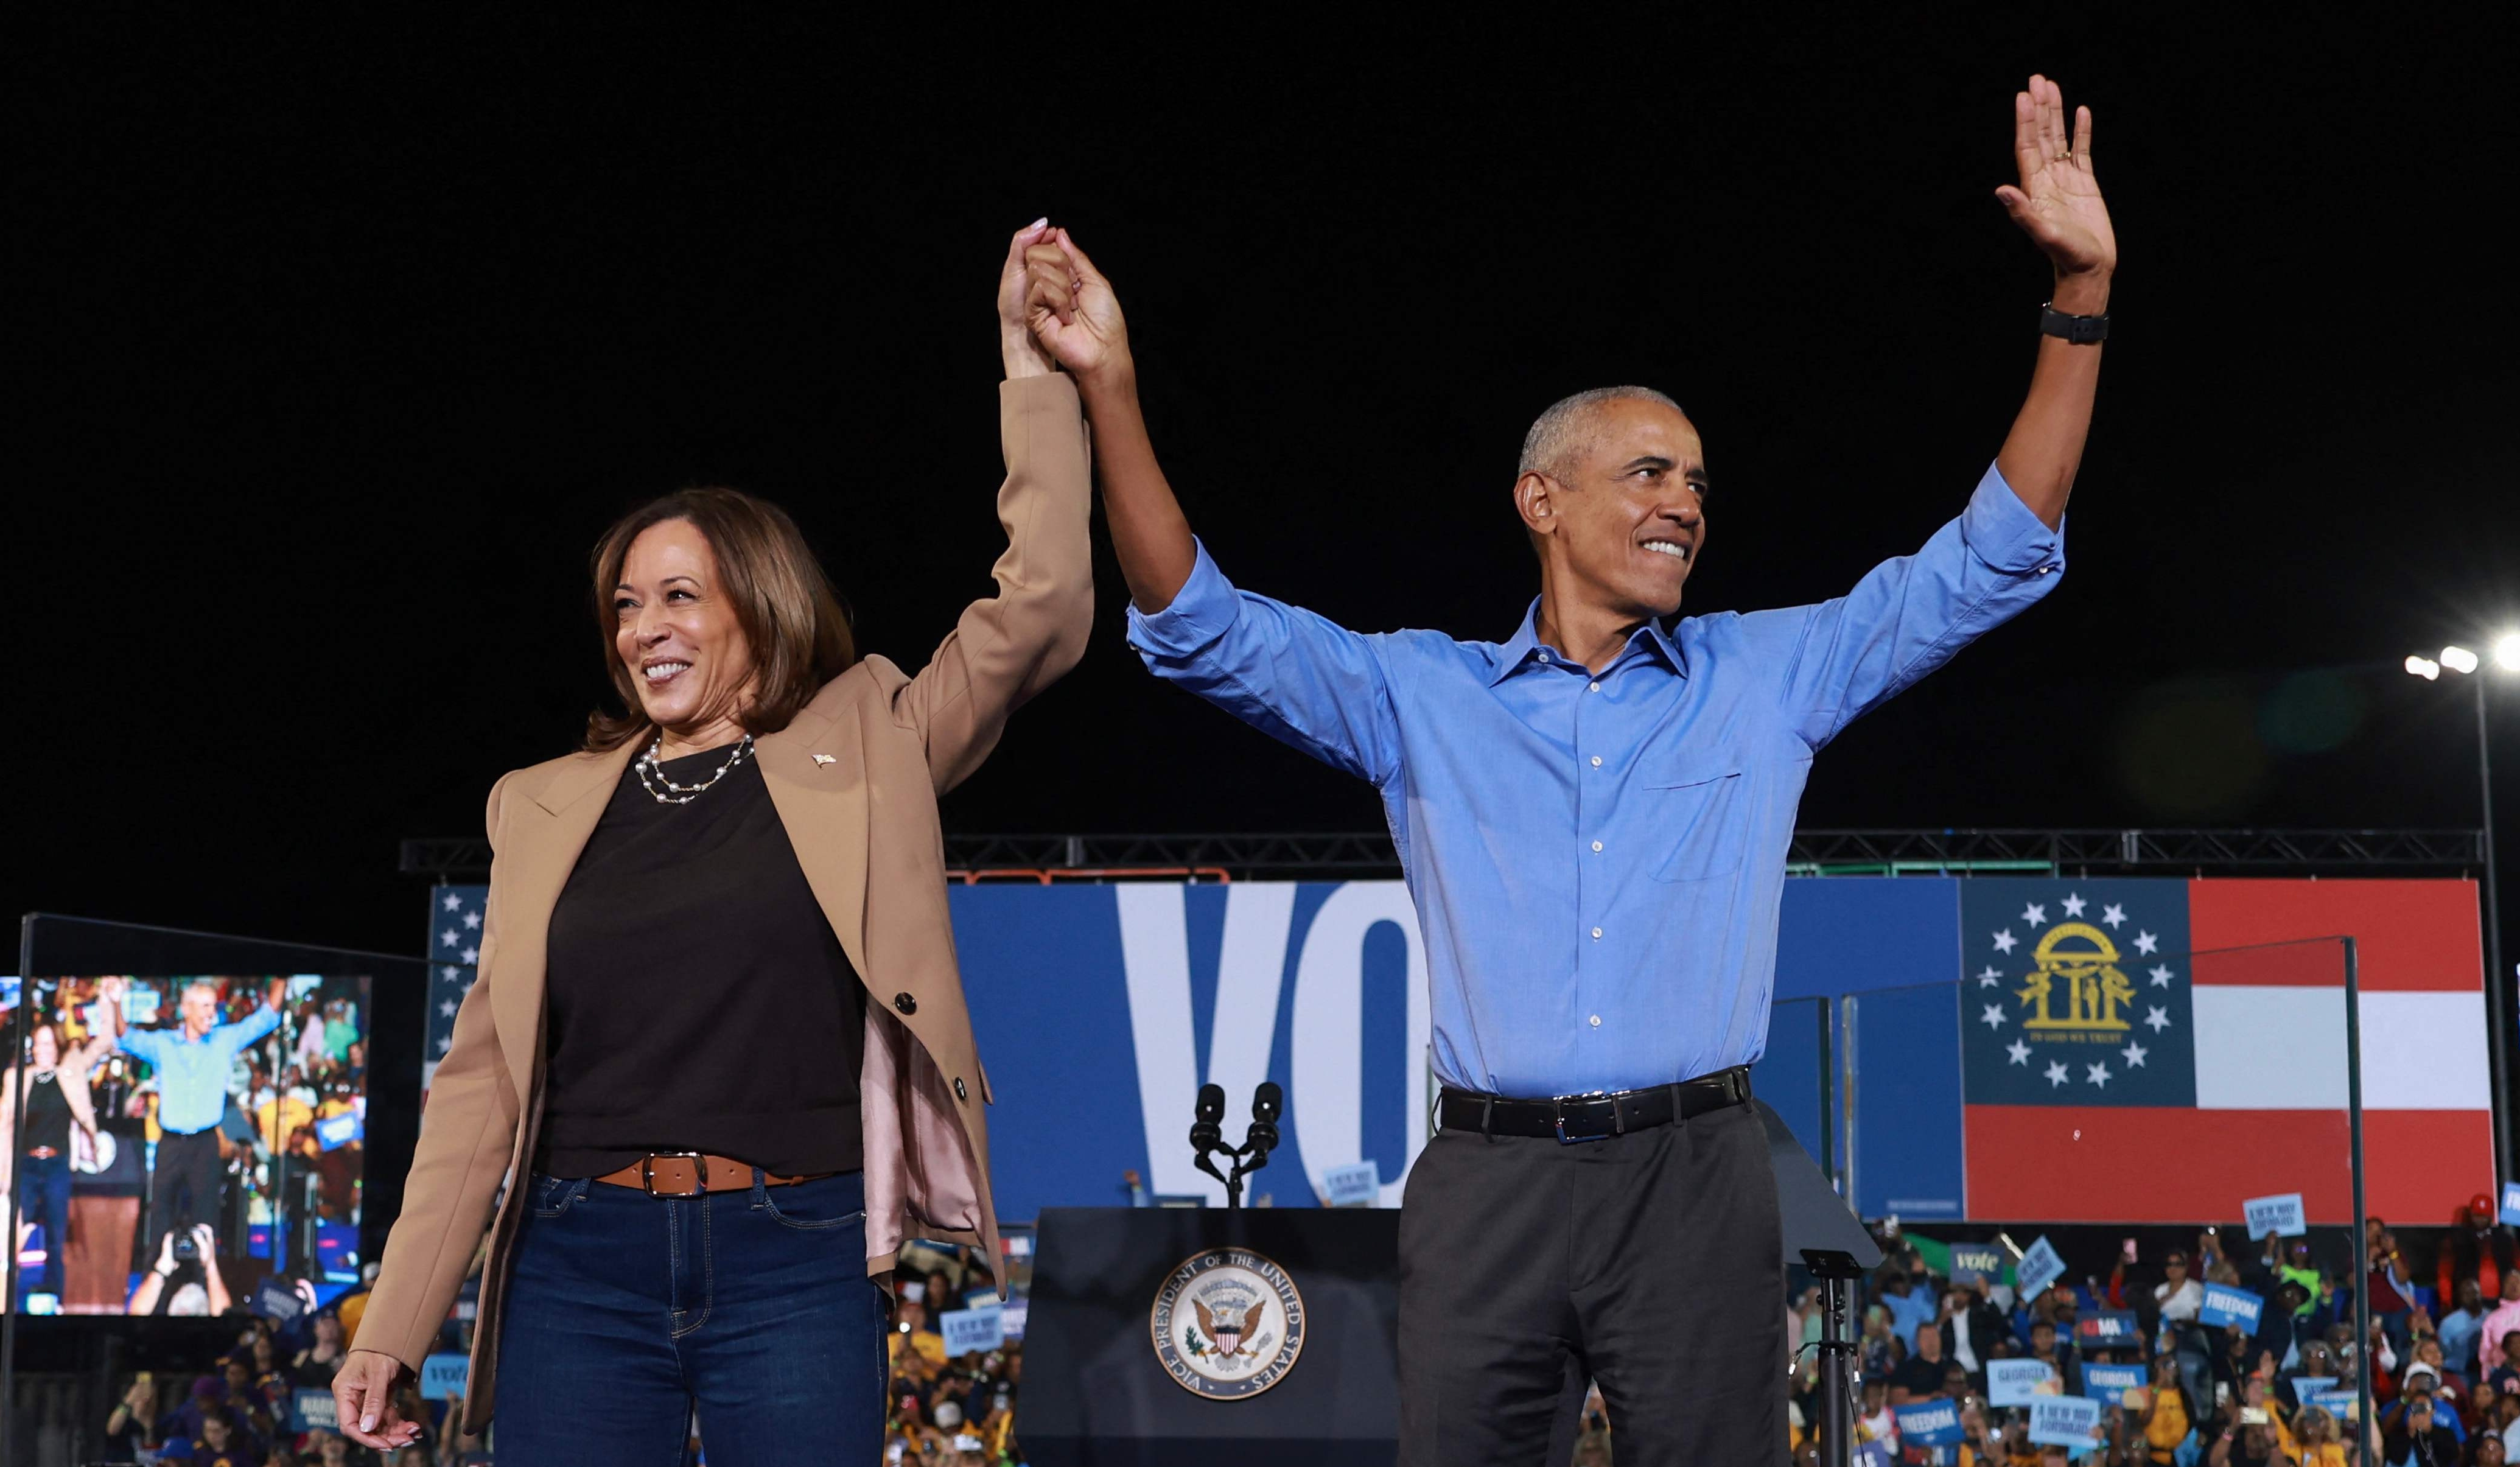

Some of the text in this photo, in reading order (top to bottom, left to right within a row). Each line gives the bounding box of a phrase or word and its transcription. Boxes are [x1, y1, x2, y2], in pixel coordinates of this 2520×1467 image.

[1956, 1251, 2000, 1272] vote
[2206, 1290, 2259, 1322] FREEDOM
[1156, 1253, 1301, 1390] VICE PRESIDENT OF THE UNITED STATES
[1998, 1366, 2047, 1383] GEORGIA
[2089, 1368, 2138, 1387] GEORGIA
[1897, 1407, 1956, 1435] FREEDOM
